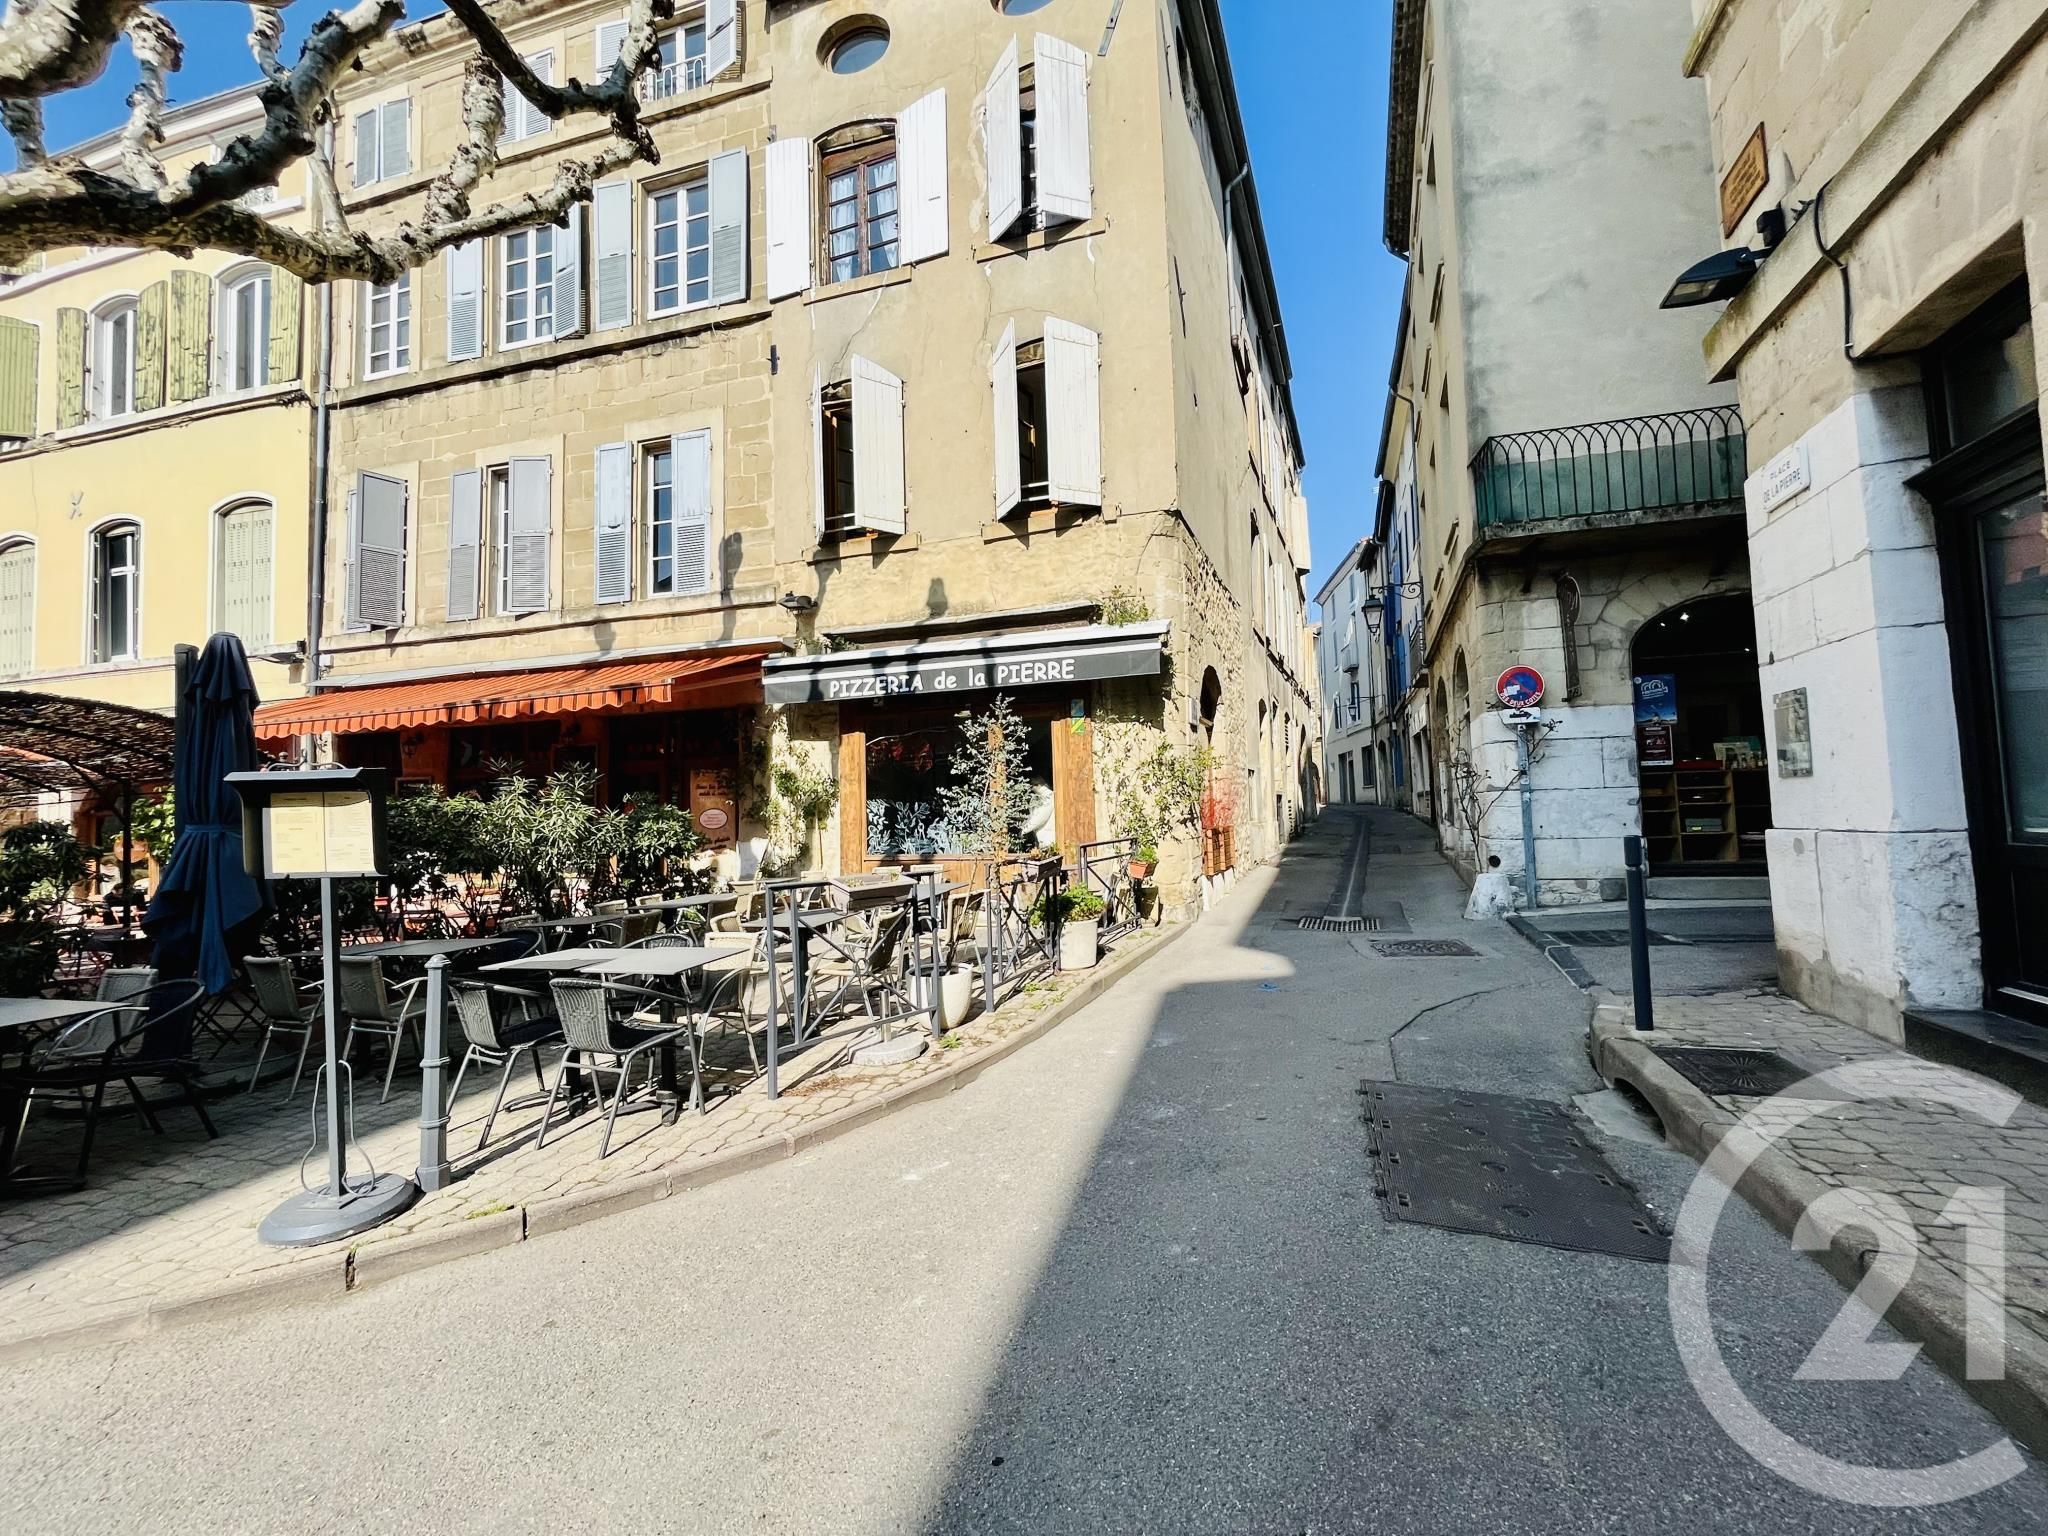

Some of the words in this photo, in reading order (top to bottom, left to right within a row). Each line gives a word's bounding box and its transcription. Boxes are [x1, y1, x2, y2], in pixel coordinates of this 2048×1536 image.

[1763, 489, 1771, 503] DE
[1771, 484, 1780, 498] LA
[1779, 467, 1801, 492] PIERRE
[1769, 460, 1791, 480] PLACE
[829, 673, 924, 699] PIZZERIA
[933, 670, 958, 690] de
[968, 667, 986, 687] la
[997, 658, 1076, 684] PIERRE
